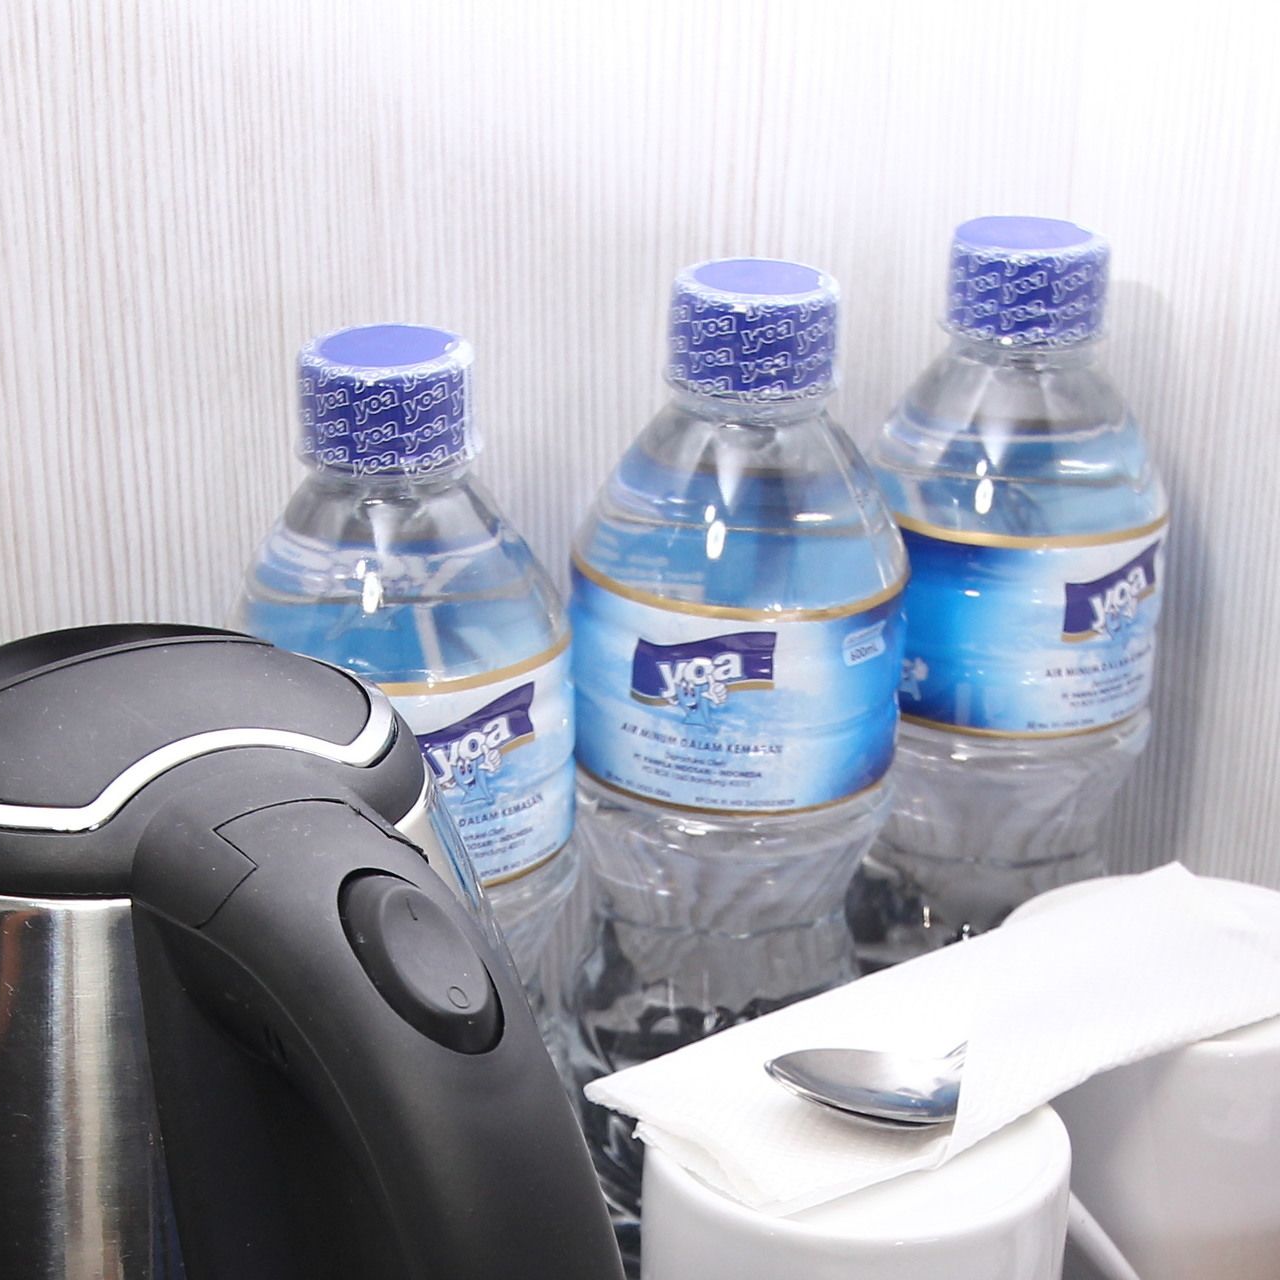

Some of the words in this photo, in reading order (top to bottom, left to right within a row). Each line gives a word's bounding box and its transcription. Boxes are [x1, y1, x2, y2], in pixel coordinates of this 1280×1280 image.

[352, 389, 399, 425] yoa
[402, 382, 449, 425] yoa
[352, 421, 400, 453] yoa
[402, 415, 449, 454] yoa
[1088, 566, 1147, 635] yoa
[656, 653, 743, 699] yoa
[427, 715, 514, 786] yoa
[680, 738, 722, 753] DALAM
[458, 811, 498, 828] DALAM
